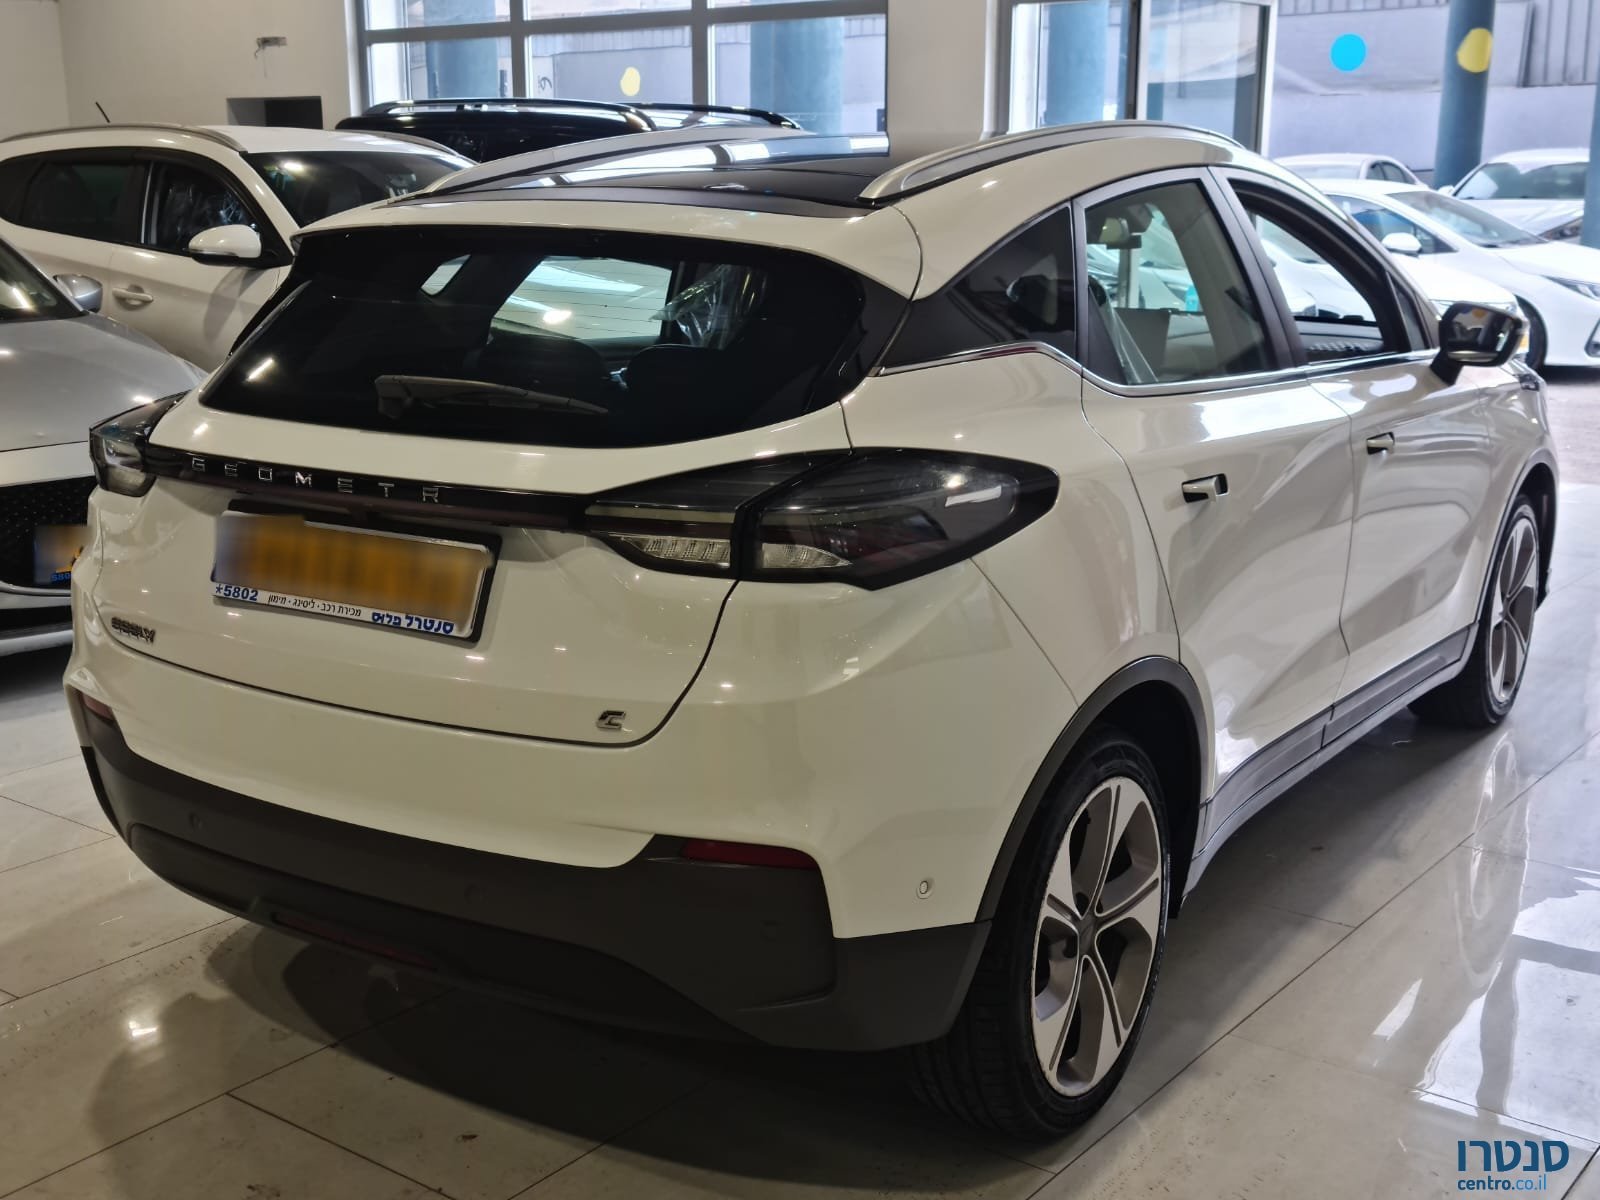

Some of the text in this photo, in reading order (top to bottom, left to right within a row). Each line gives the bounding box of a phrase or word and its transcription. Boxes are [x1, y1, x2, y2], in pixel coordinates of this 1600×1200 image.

[321, 602, 336, 613] רכב
[337, 604, 362, 617] מכירת
[372, 611, 402, 627] פלוס
[404, 613, 455, 635] סנטרל
